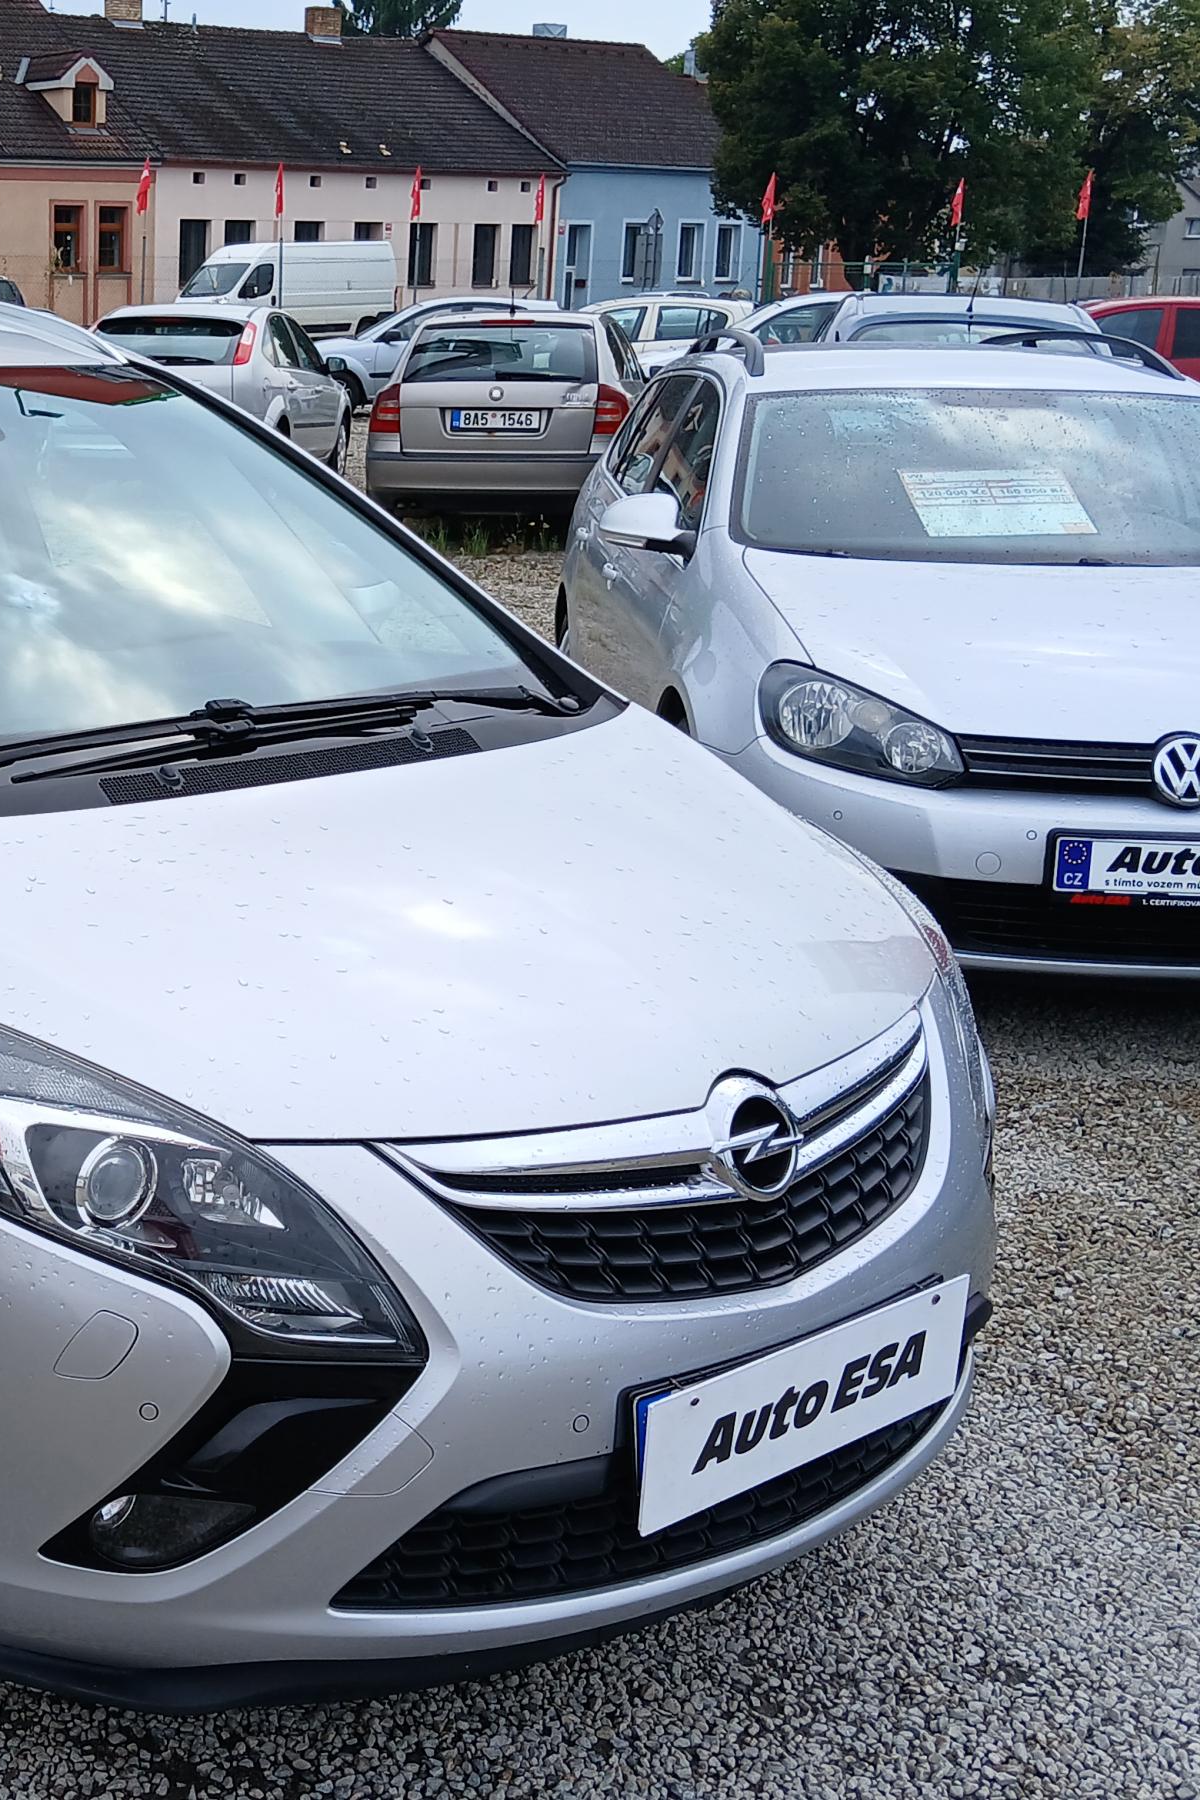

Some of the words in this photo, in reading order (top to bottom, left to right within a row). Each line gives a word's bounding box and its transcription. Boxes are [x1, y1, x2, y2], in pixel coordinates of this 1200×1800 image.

[463, 412, 489, 426] 8A5
[500, 413, 533, 426] 1546
[1063, 872, 1083, 886] CZ
[1104, 879, 1110, 887] s
[1113, 877, 1144, 888] tímto
[1147, 880, 1184, 889] vozem
[690, 1380, 829, 1475] Auto
[830, 1329, 928, 1413] ESA
